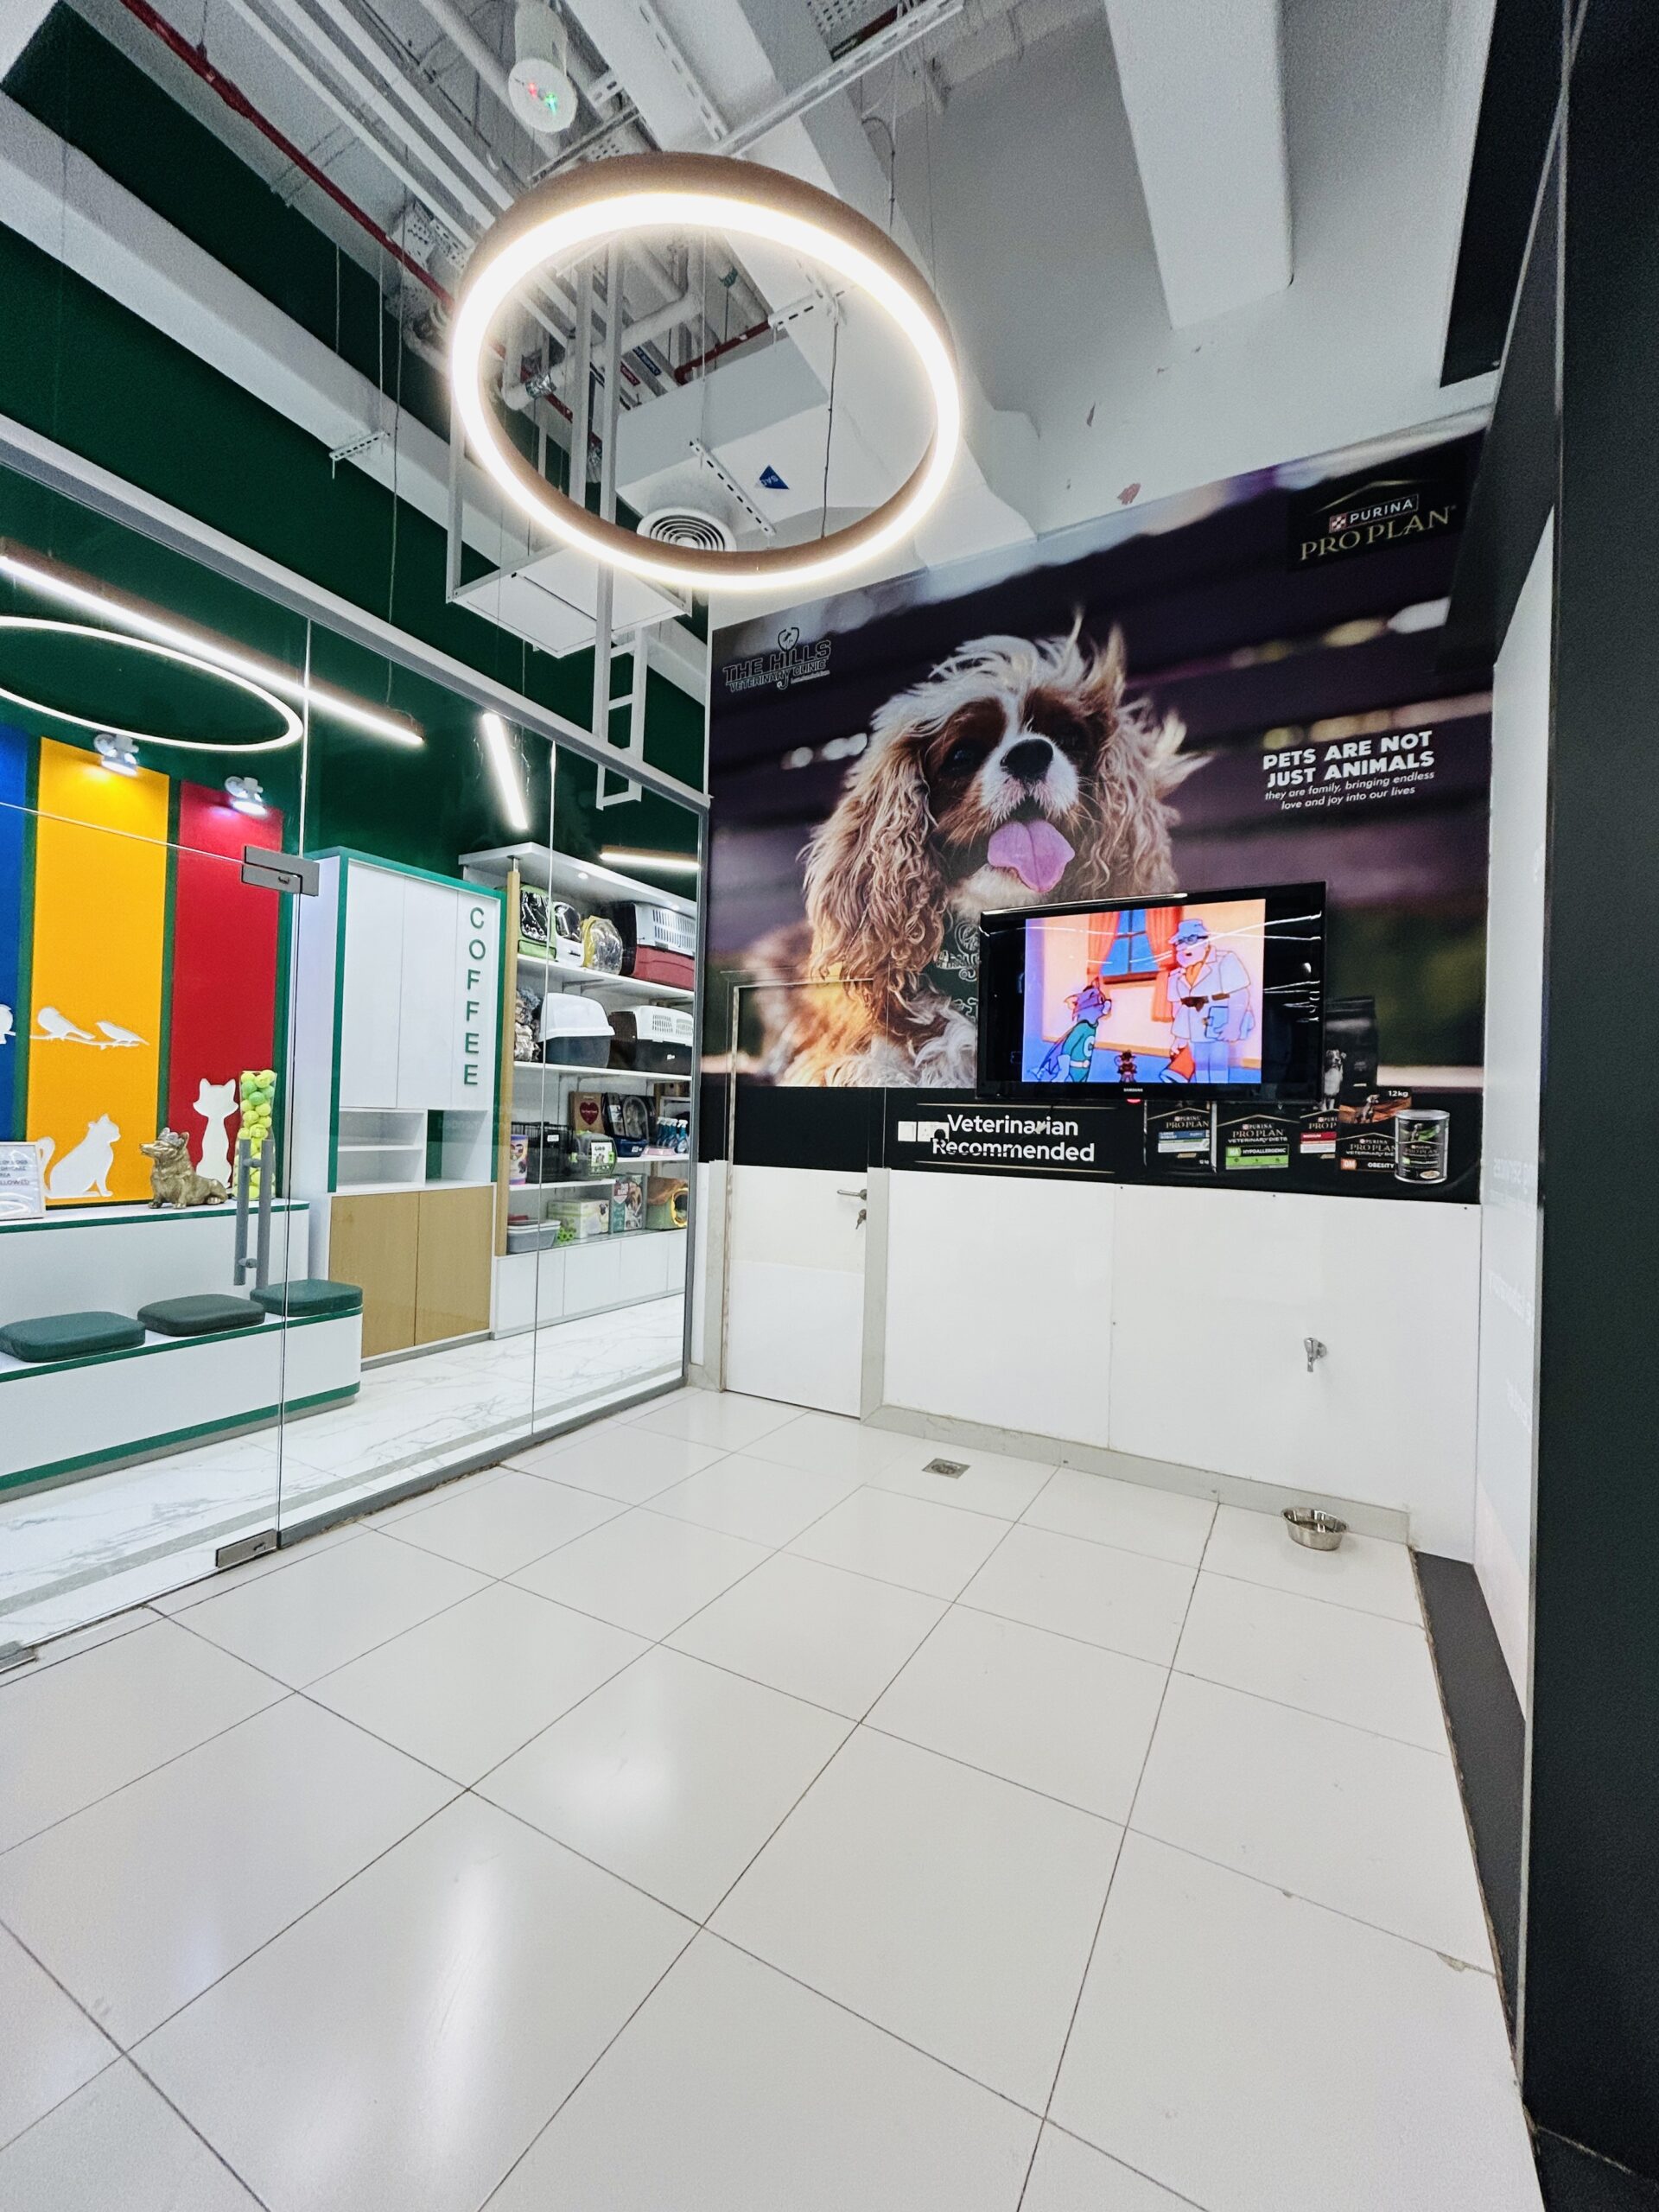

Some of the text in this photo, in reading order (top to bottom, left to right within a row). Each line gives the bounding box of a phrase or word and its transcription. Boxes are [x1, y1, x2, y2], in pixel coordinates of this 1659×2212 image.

[1349, 498, 1414, 524] PURINA
[1300, 505, 1451, 561] PRO PLAN
[722, 658, 764, 683] THE
[770, 640, 831, 671] HILLS
[728, 667, 791, 693] VETERINARY
[792, 658, 827, 676] CLINIC
[1262, 730, 1433, 771] PETS ARE NOT
[1268, 750, 1435, 789] JUST ANIMALS
[1265, 771, 1435, 801] they are family, bringing endless
[1281, 786, 1416, 810] love and joy into our lives
[464, 906, 486, 1085] COFFEE
[946, 1114, 1079, 1136] Veterinarian
[1166, 1121, 1185, 1129] PRO
[1255, 1128, 1284, 1137] PLAN
[932, 1137, 1095, 1162] Recommended
